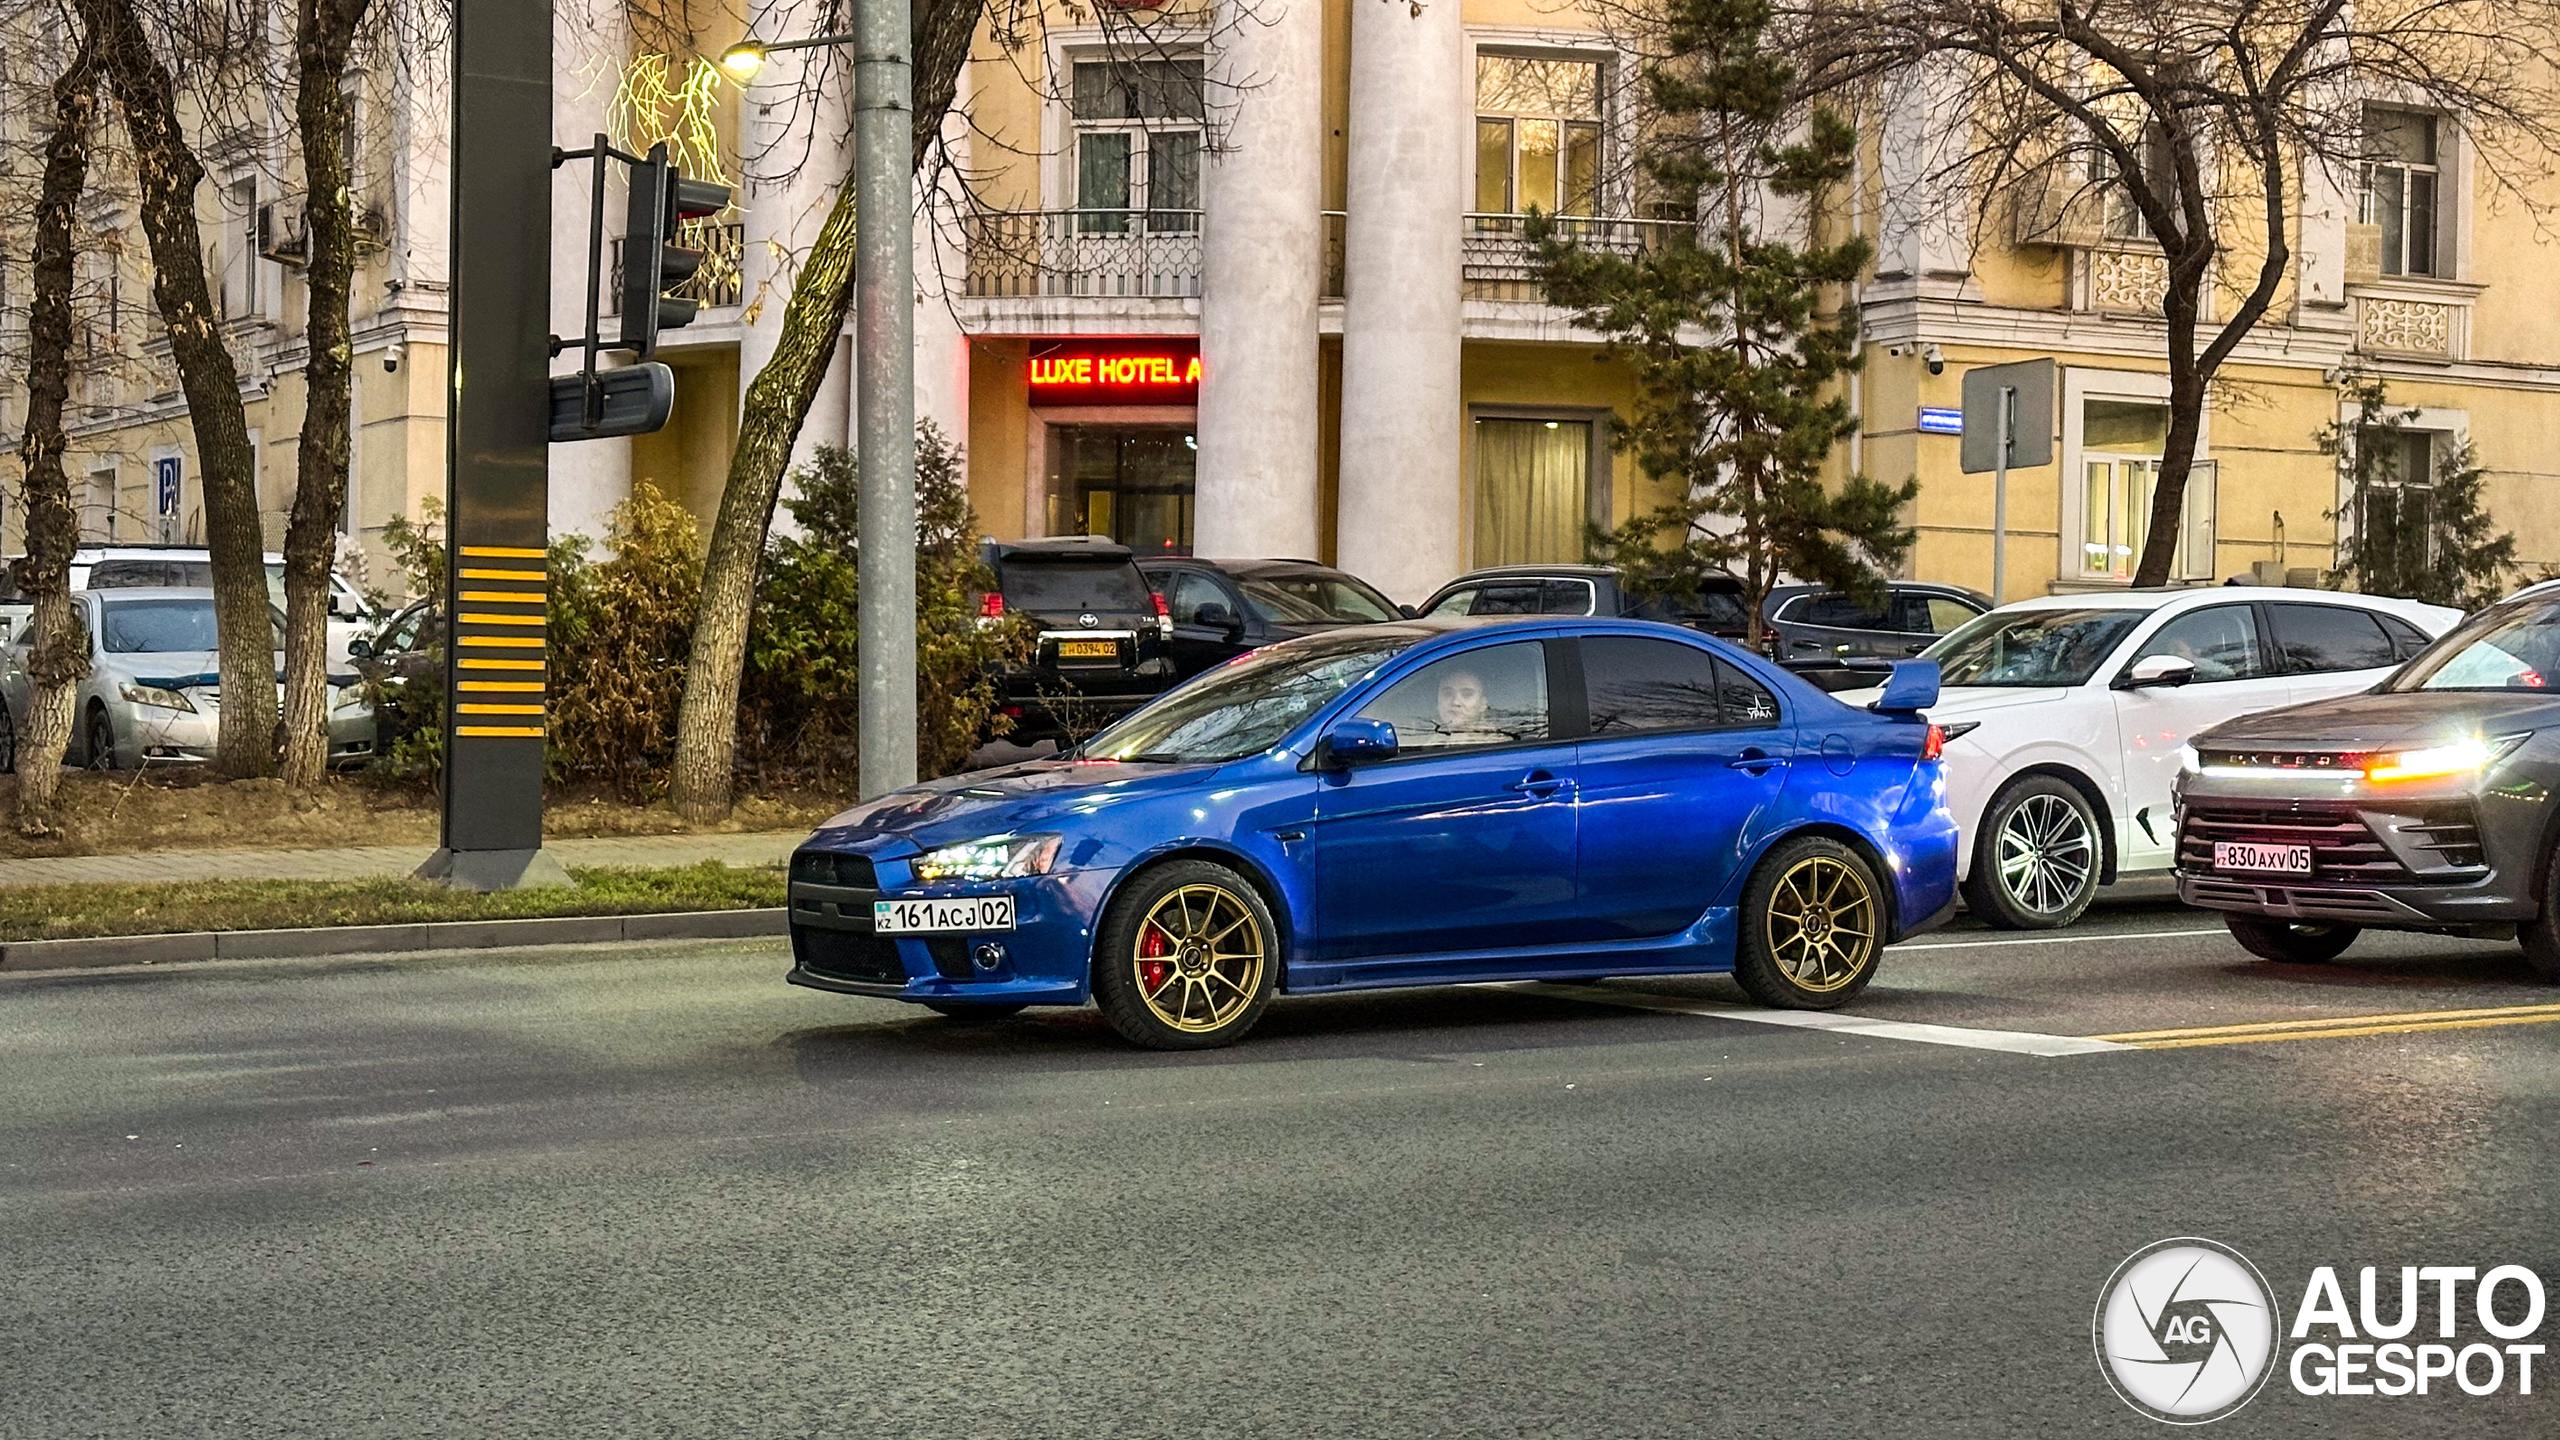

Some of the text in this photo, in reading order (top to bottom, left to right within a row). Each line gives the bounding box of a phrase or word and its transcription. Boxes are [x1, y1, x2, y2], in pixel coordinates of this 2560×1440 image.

[1031, 358, 1092, 384] LUXE
[1098, 357, 1181, 384] HOTEL
[163, 463, 174, 511] P
[1103, 643, 1116, 654] 02
[2289, 849, 2309, 869] 05
[877, 918, 891, 929] KZ
[981, 901, 1010, 926] 02
